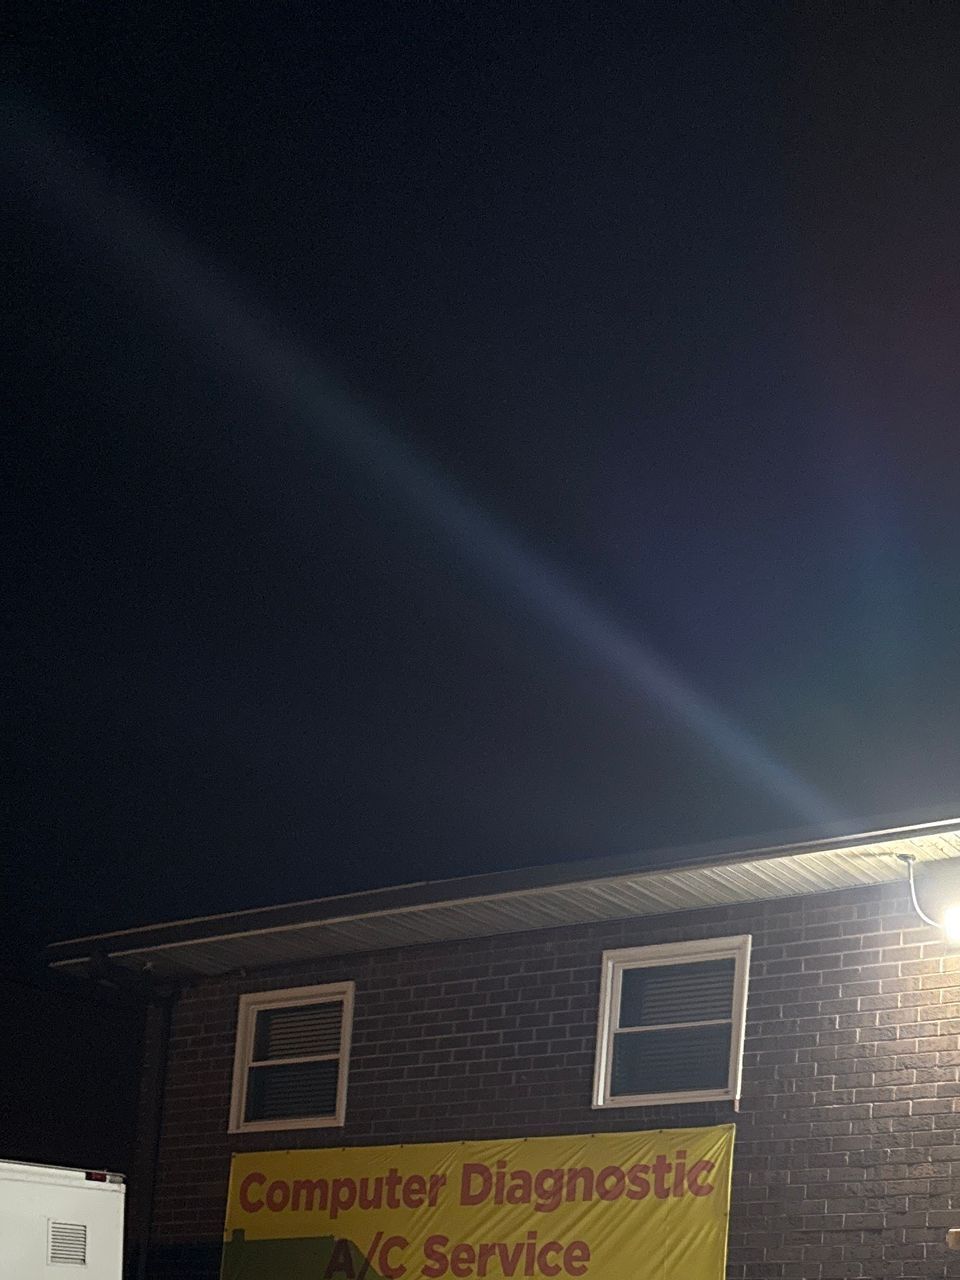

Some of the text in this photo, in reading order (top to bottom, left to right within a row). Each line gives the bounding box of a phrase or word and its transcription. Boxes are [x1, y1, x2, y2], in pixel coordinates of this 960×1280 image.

[238, 1149, 715, 1219] Computer Diagnostic
[423, 1231, 591, 1279] Service
